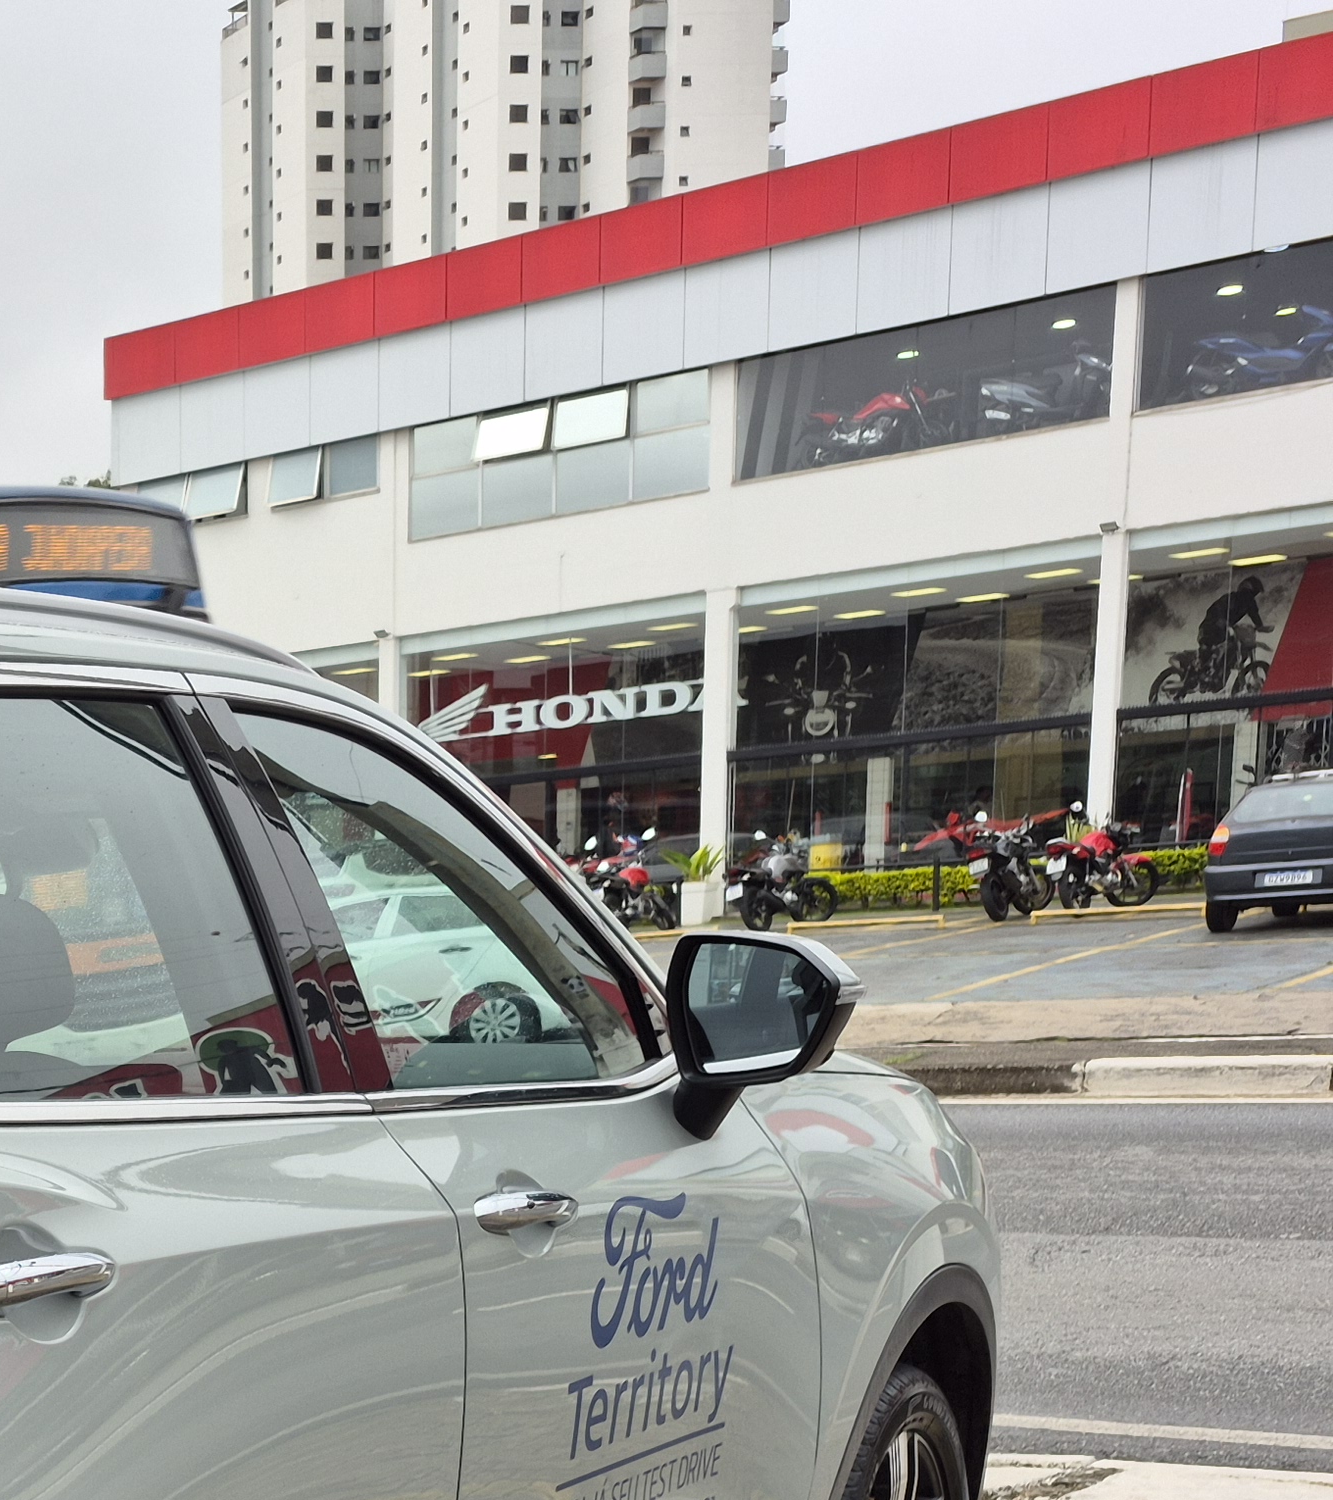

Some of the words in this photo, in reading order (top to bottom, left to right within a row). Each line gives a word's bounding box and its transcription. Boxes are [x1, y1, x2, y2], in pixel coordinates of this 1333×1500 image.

[590, 1192, 720, 1349] Ford
[568, 1344, 734, 1460] Territory
[676, 1442, 723, 1490] DRIVE
